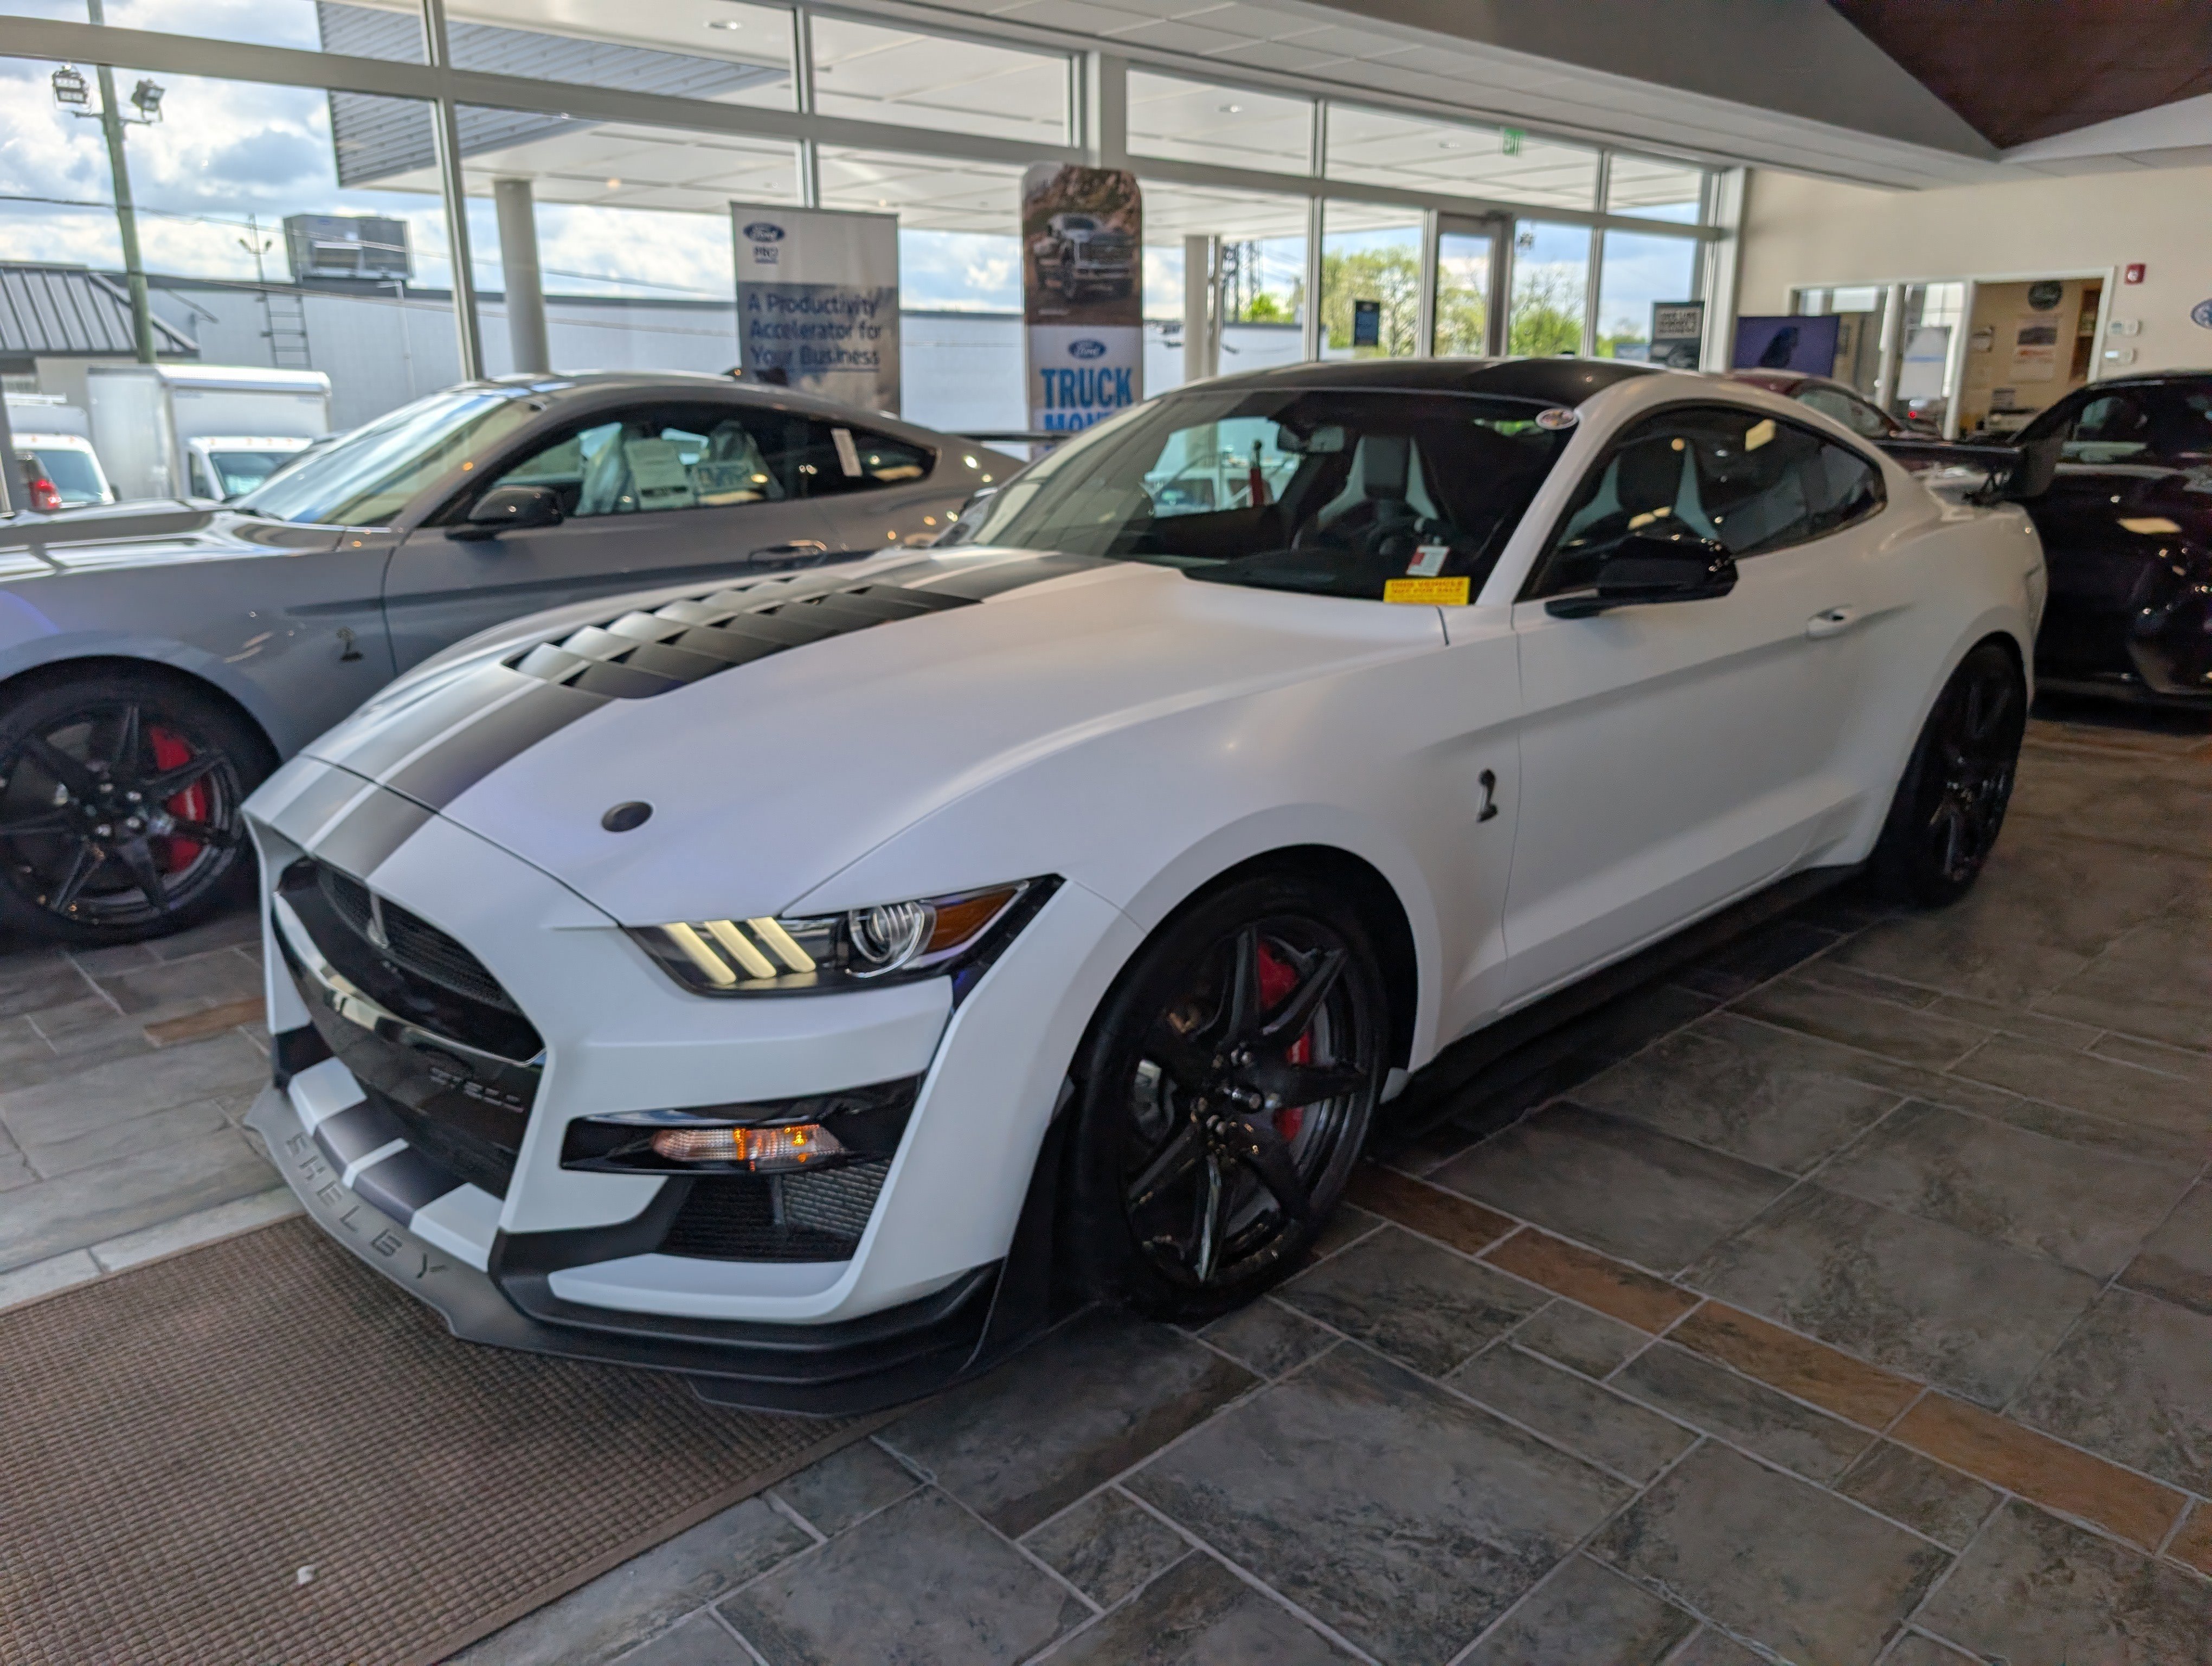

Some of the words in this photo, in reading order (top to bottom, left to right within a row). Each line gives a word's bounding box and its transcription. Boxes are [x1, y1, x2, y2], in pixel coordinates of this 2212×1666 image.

[747, 293, 762, 312] A
[767, 293, 879, 318] Productivity
[750, 321, 852, 340] Accelerator
[858, 322, 882, 339] for
[800, 347, 880, 366] Business
[1040, 367, 1133, 408] TRUCK
[286, 1132, 447, 1279] SHELBY
